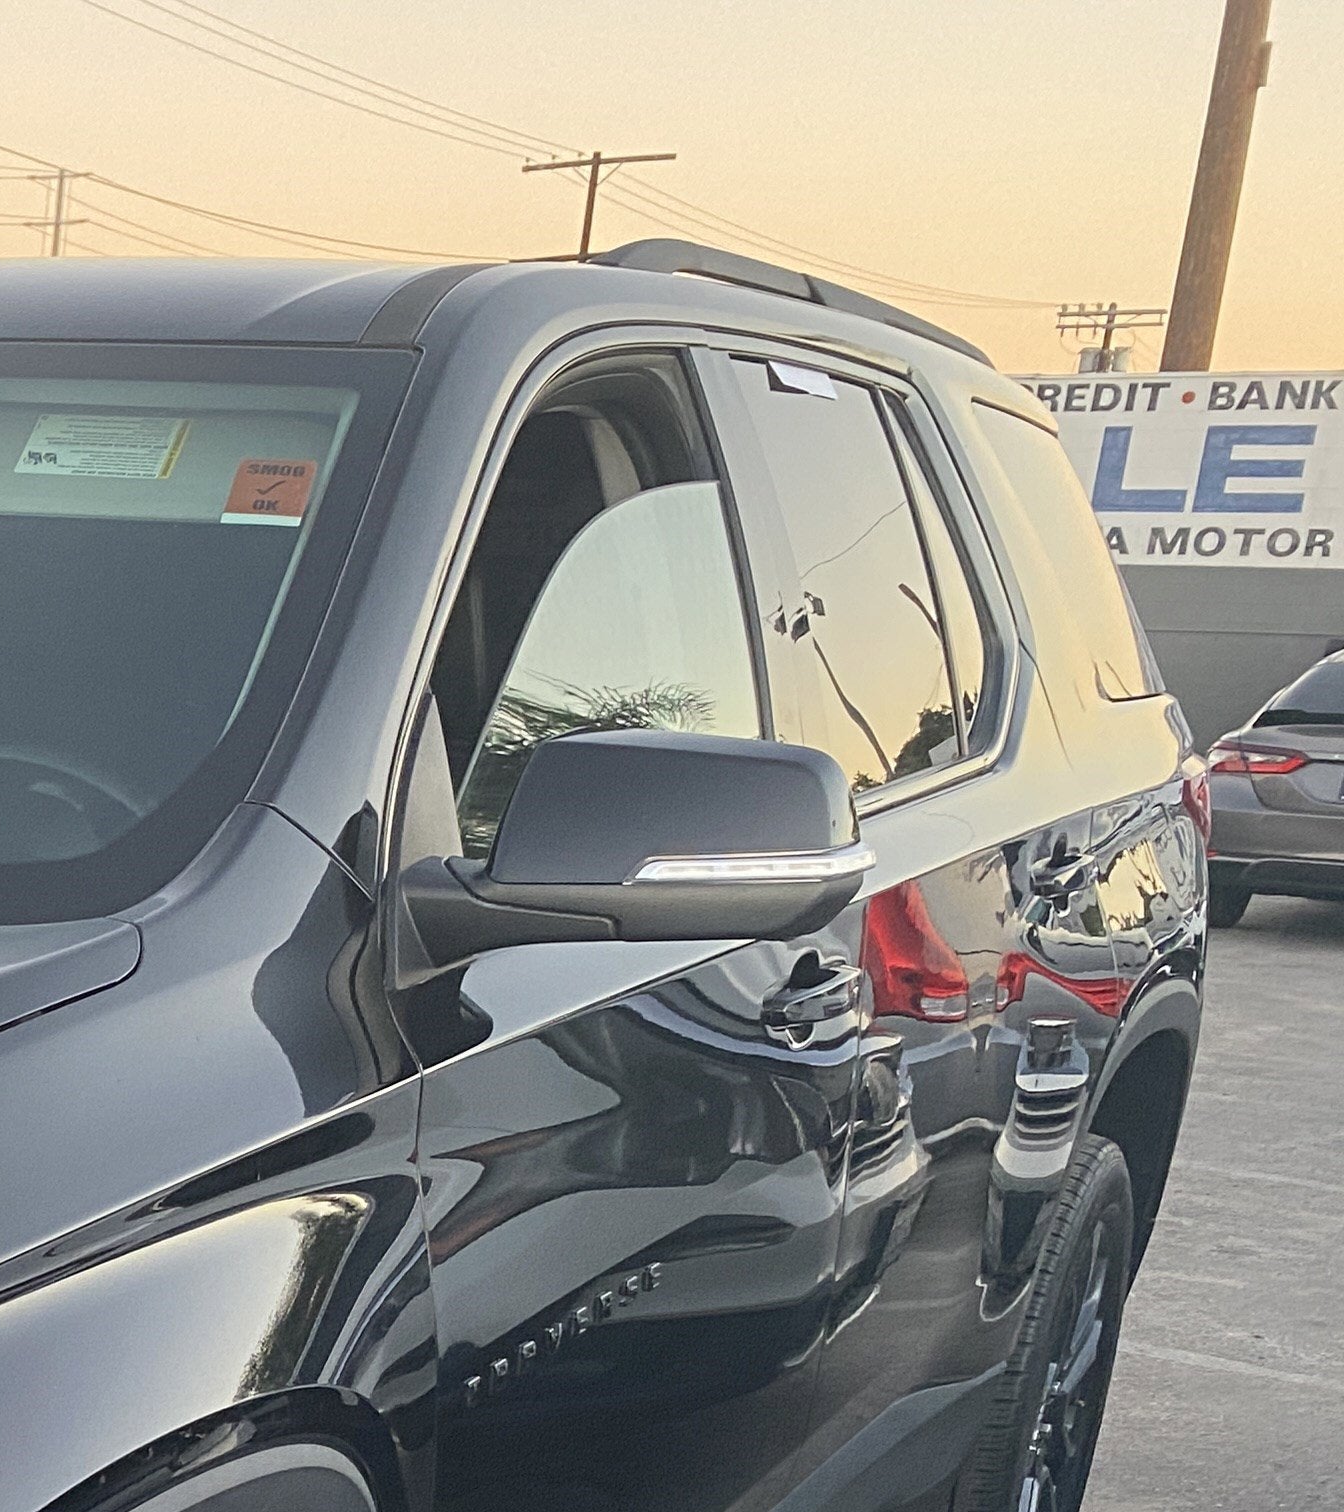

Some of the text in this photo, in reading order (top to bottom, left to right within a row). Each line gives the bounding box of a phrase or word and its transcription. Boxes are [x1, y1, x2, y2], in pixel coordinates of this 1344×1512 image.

[1207, 379, 1343, 410] BANK
[252, 499, 281, 511] OK
[1146, 526, 1335, 557] MOTOR
[464, 1262, 662, 1403] TRAVERSE
